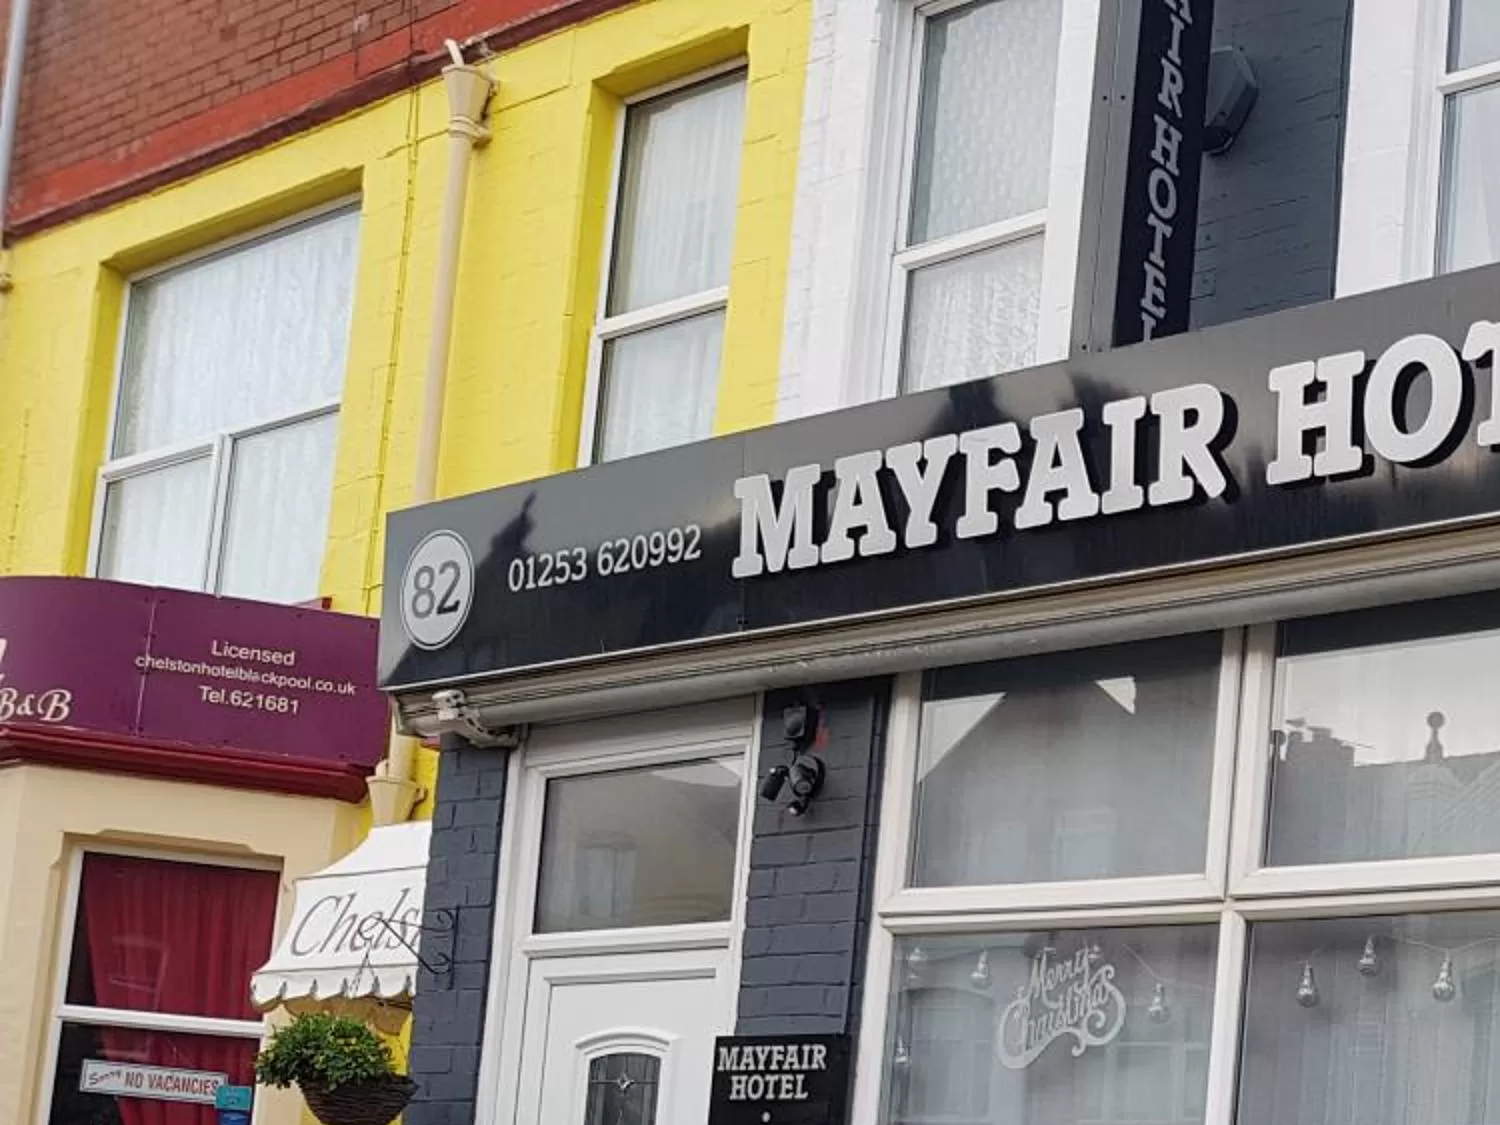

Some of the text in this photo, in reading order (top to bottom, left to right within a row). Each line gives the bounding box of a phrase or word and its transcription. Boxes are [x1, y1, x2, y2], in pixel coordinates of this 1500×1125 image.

[1158, 0, 1193, 118] IR
[731, 382, 1227, 580] MAYFAIR
[508, 523, 703, 593] 01253 620992
[411, 560, 462, 620] 82
[211, 639, 296, 667] Licensed
[134, 653, 356, 697] chelstonhotelblackpool.co.uk
[199, 684, 300, 715] Tel.621681
[716, 1044, 828, 1072] MAYFAIR
[124, 1071, 145, 1089] NO
[148, 1073, 219, 1097] VACANCIES
[728, 1073, 810, 1101] HOTEL
